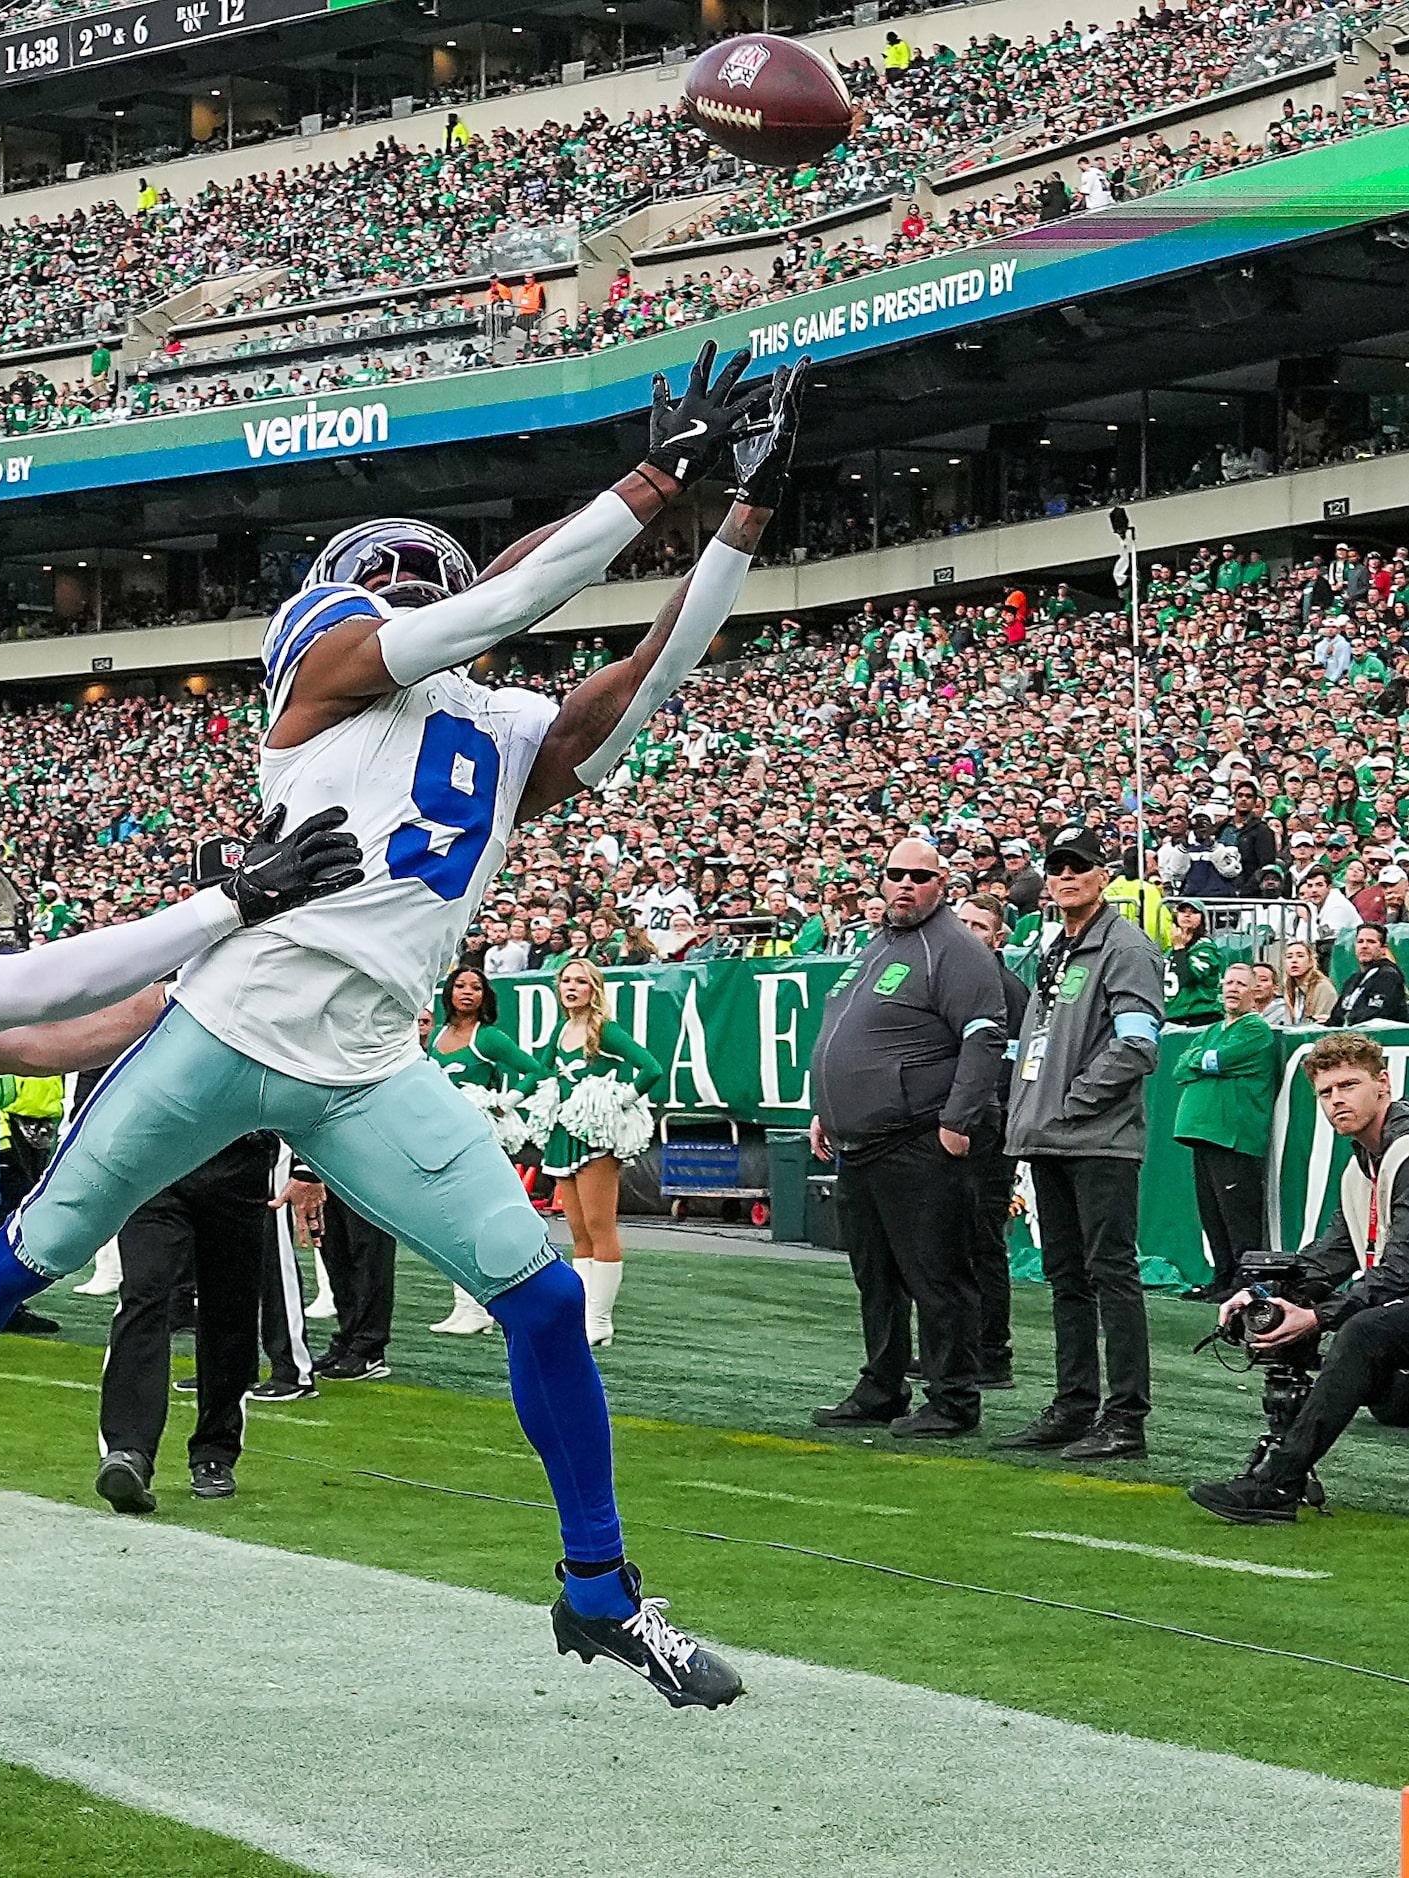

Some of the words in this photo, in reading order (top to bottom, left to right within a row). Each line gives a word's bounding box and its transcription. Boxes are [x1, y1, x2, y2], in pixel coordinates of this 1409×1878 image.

[176, 2, 209, 22] BALL
[182, 17, 202, 33] ON
[217, 0, 244, 26] 12
[79, 23, 111, 56] 2ND
[112, 26, 127, 45] &
[133, 15, 149, 45] 6
[4, 36, 59, 74] 14:38
[748, 321, 789, 359] THIS
[792, 306, 846, 347] GAME
[850, 299, 868, 334] IS
[872, 268, 985, 327] PRESENTED
[988, 258, 1018, 297] BY
[243, 400, 388, 459] verizon
[5, 455, 35, 483] BY
[385, 709, 500, 901] 9
[650, 906, 673, 930] 26
